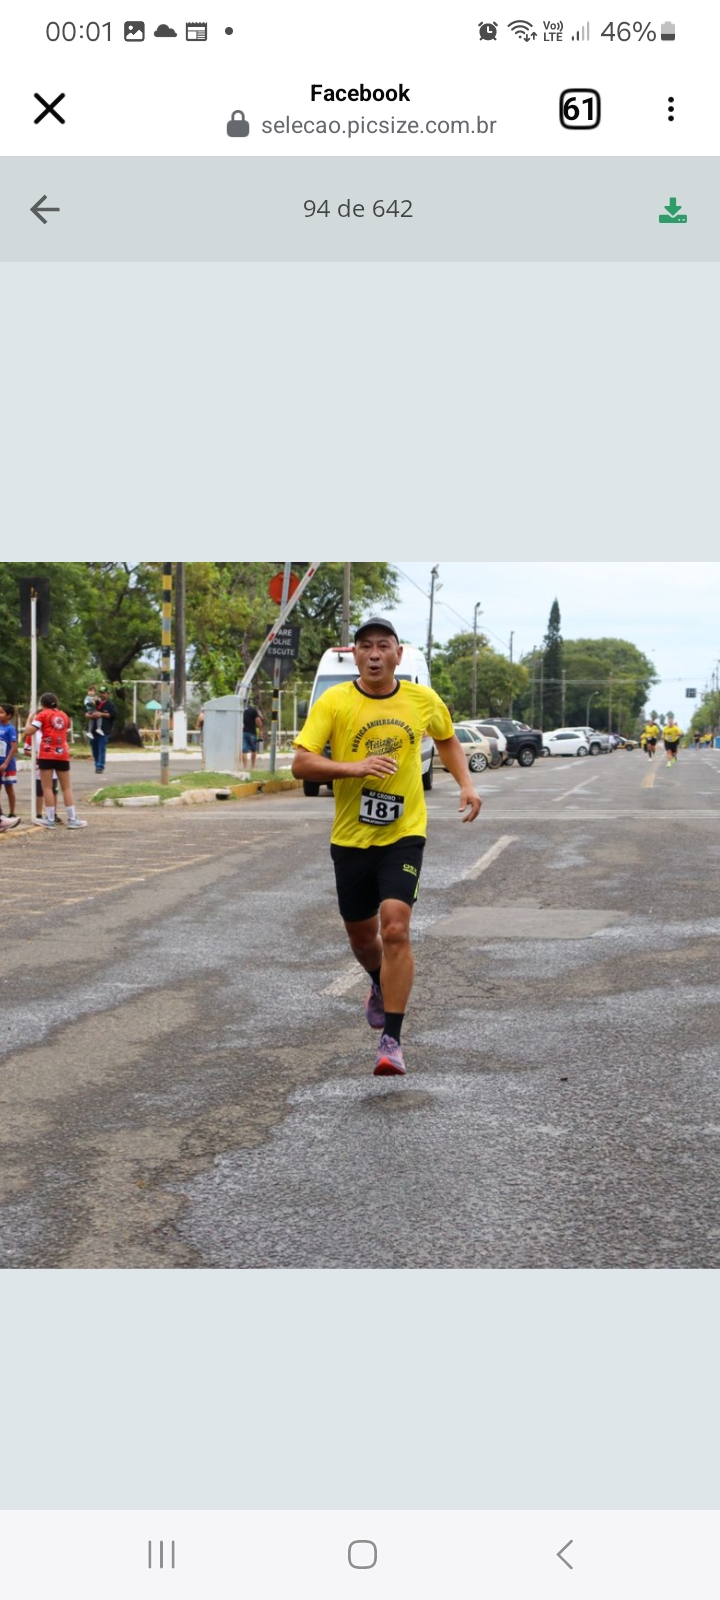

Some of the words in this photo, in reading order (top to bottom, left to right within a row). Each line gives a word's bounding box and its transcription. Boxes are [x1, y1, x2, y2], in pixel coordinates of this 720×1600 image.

[45, 21, 111, 42] 00:01
[543, 32, 563, 42] LTE
[600, 21, 657, 42] 46%
[310, 84, 411, 102] Facebook
[563, 96, 593, 121] 61
[261, 115, 498, 139] selecao.picsize.com.br
[303, 198, 331, 218] 94
[337, 198, 365, 218] de
[372, 198, 413, 218] 642
[267, 647, 295, 656] ESCUTE
[363, 799, 400, 819] 181
